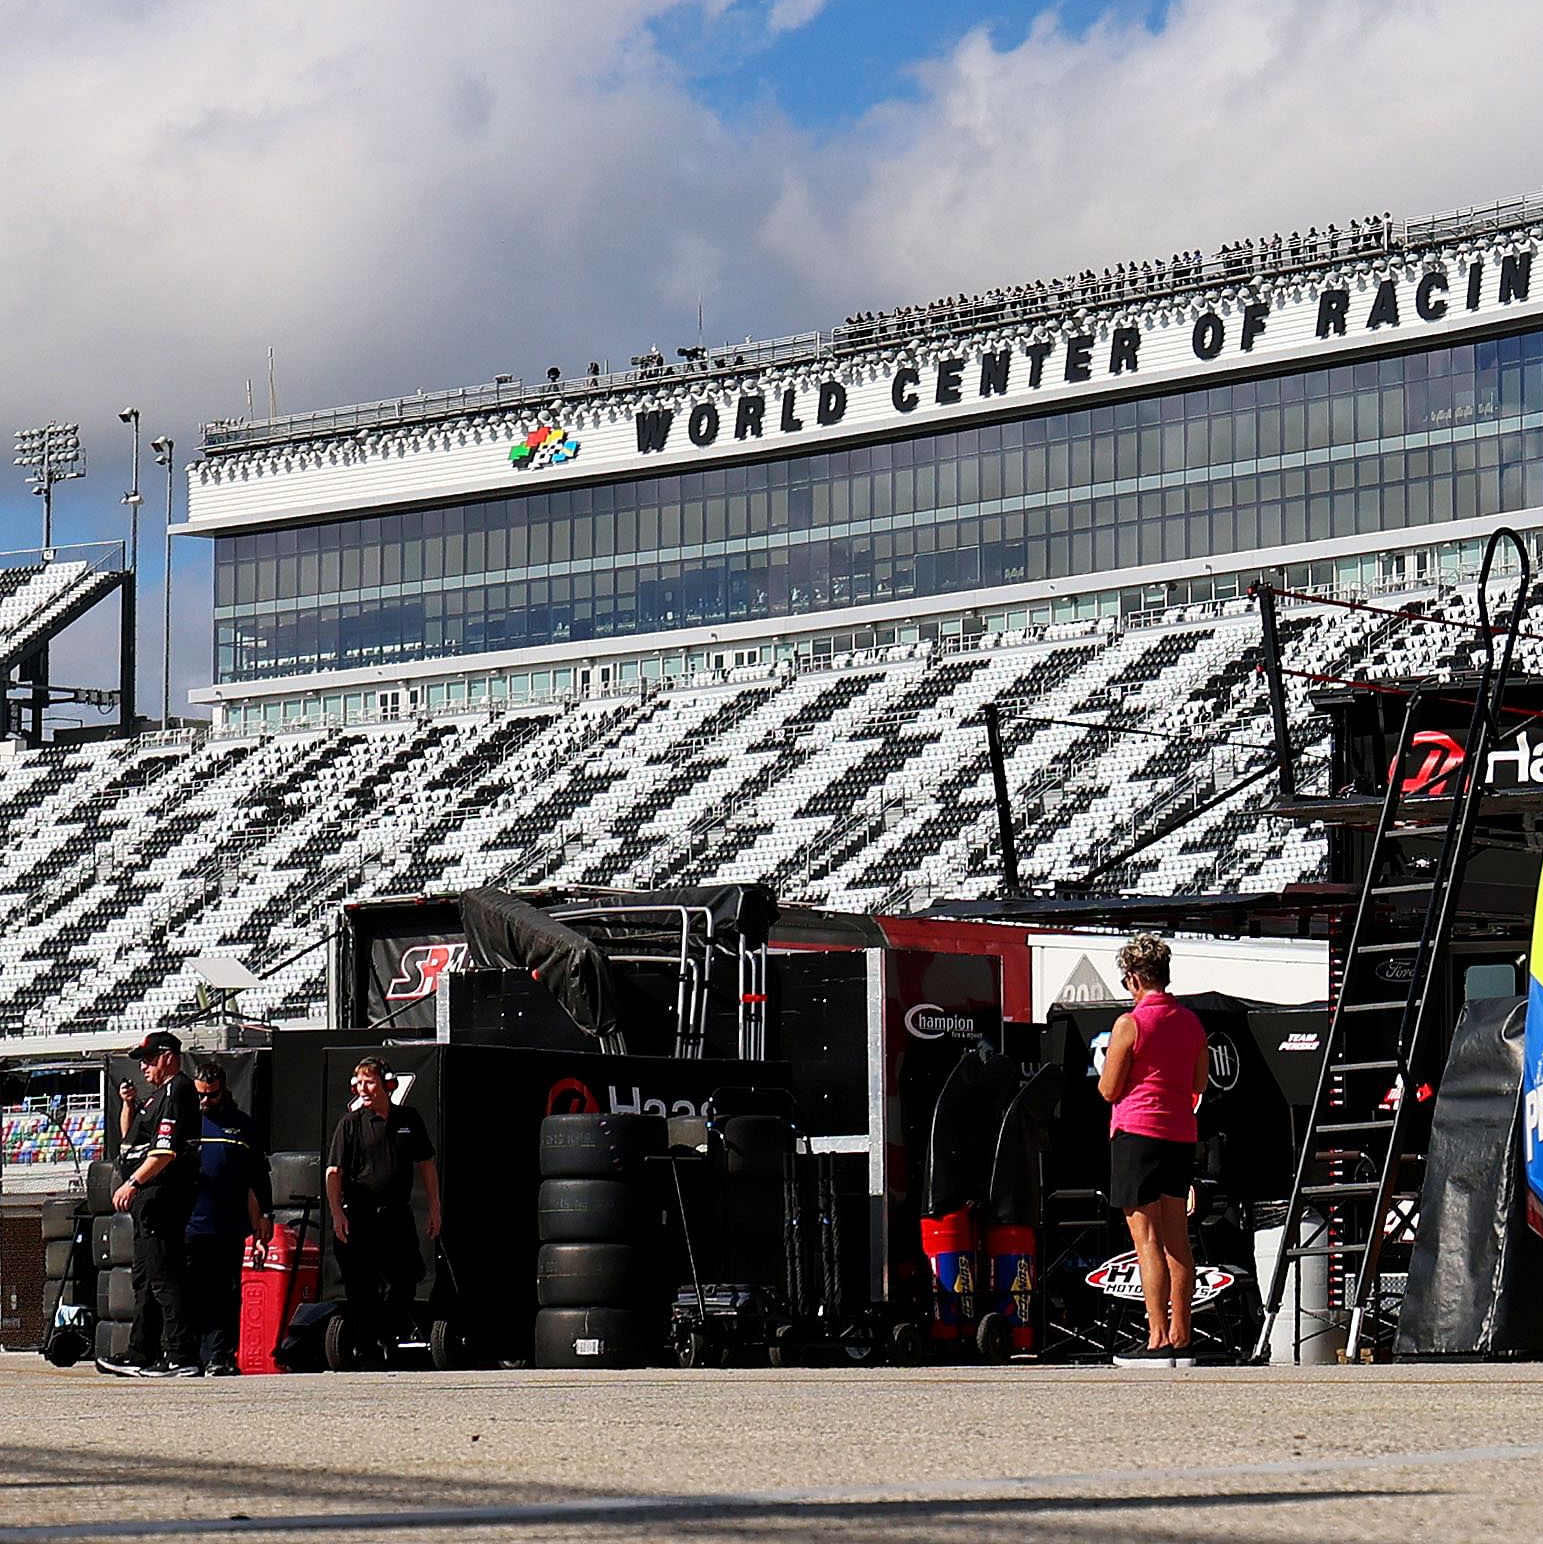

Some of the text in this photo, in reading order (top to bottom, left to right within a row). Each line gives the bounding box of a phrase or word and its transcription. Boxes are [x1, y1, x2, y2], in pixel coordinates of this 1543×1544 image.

[636, 380, 847, 454] WORLD
[892, 326, 1141, 413] CENTER
[1193, 301, 1270, 360] OF
[904, 1003, 975, 1040] Champion
[247, 1285, 264, 1373] RECYCLE
